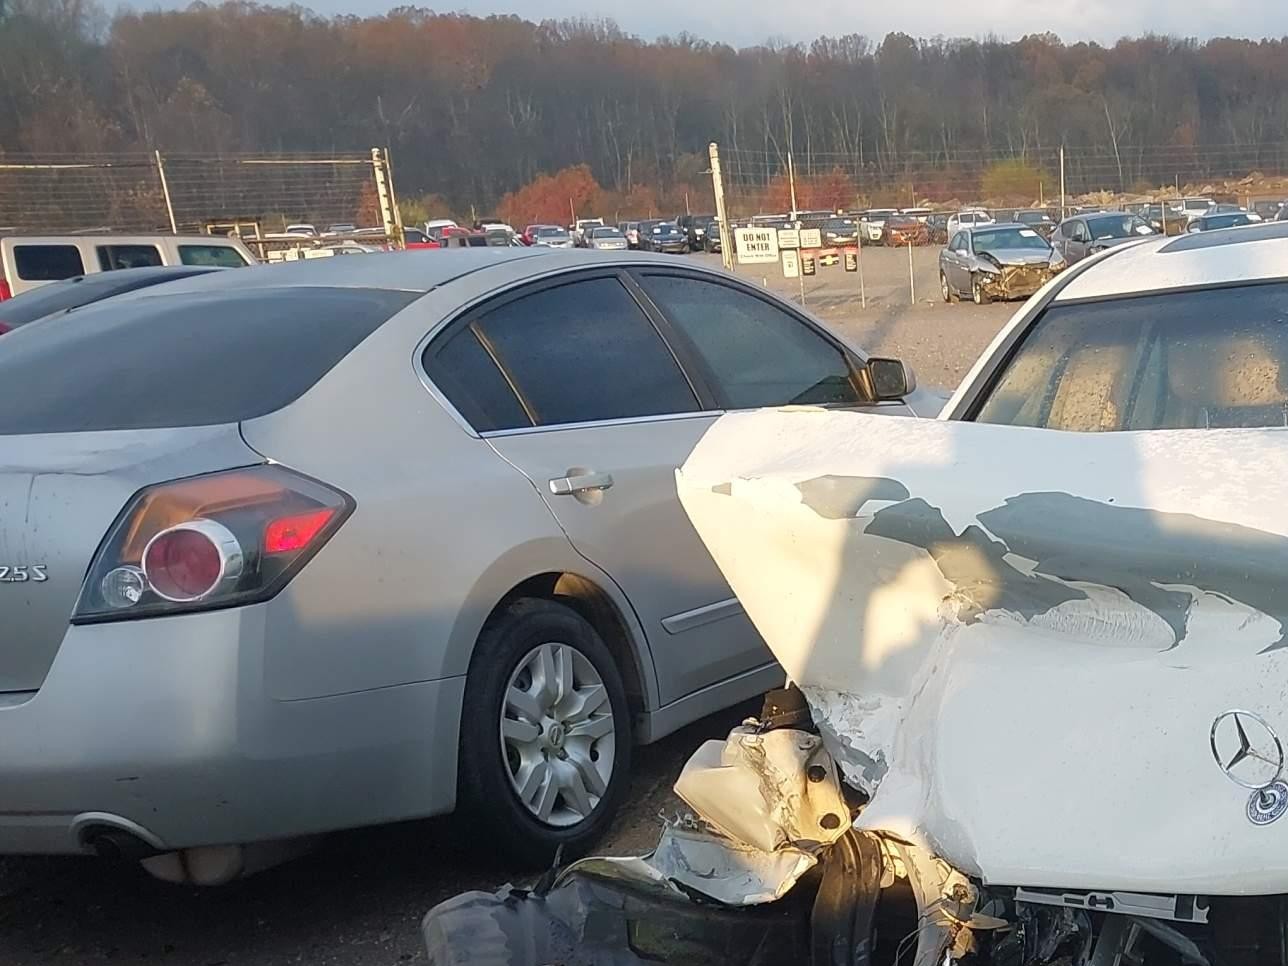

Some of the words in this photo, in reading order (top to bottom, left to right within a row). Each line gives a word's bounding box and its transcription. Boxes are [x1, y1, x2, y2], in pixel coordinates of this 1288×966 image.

[743, 233, 754, 241] DO
[756, 233, 770, 241] NOT
[746, 242, 770, 251] ENTER
[32, 564, 48, 582] S
